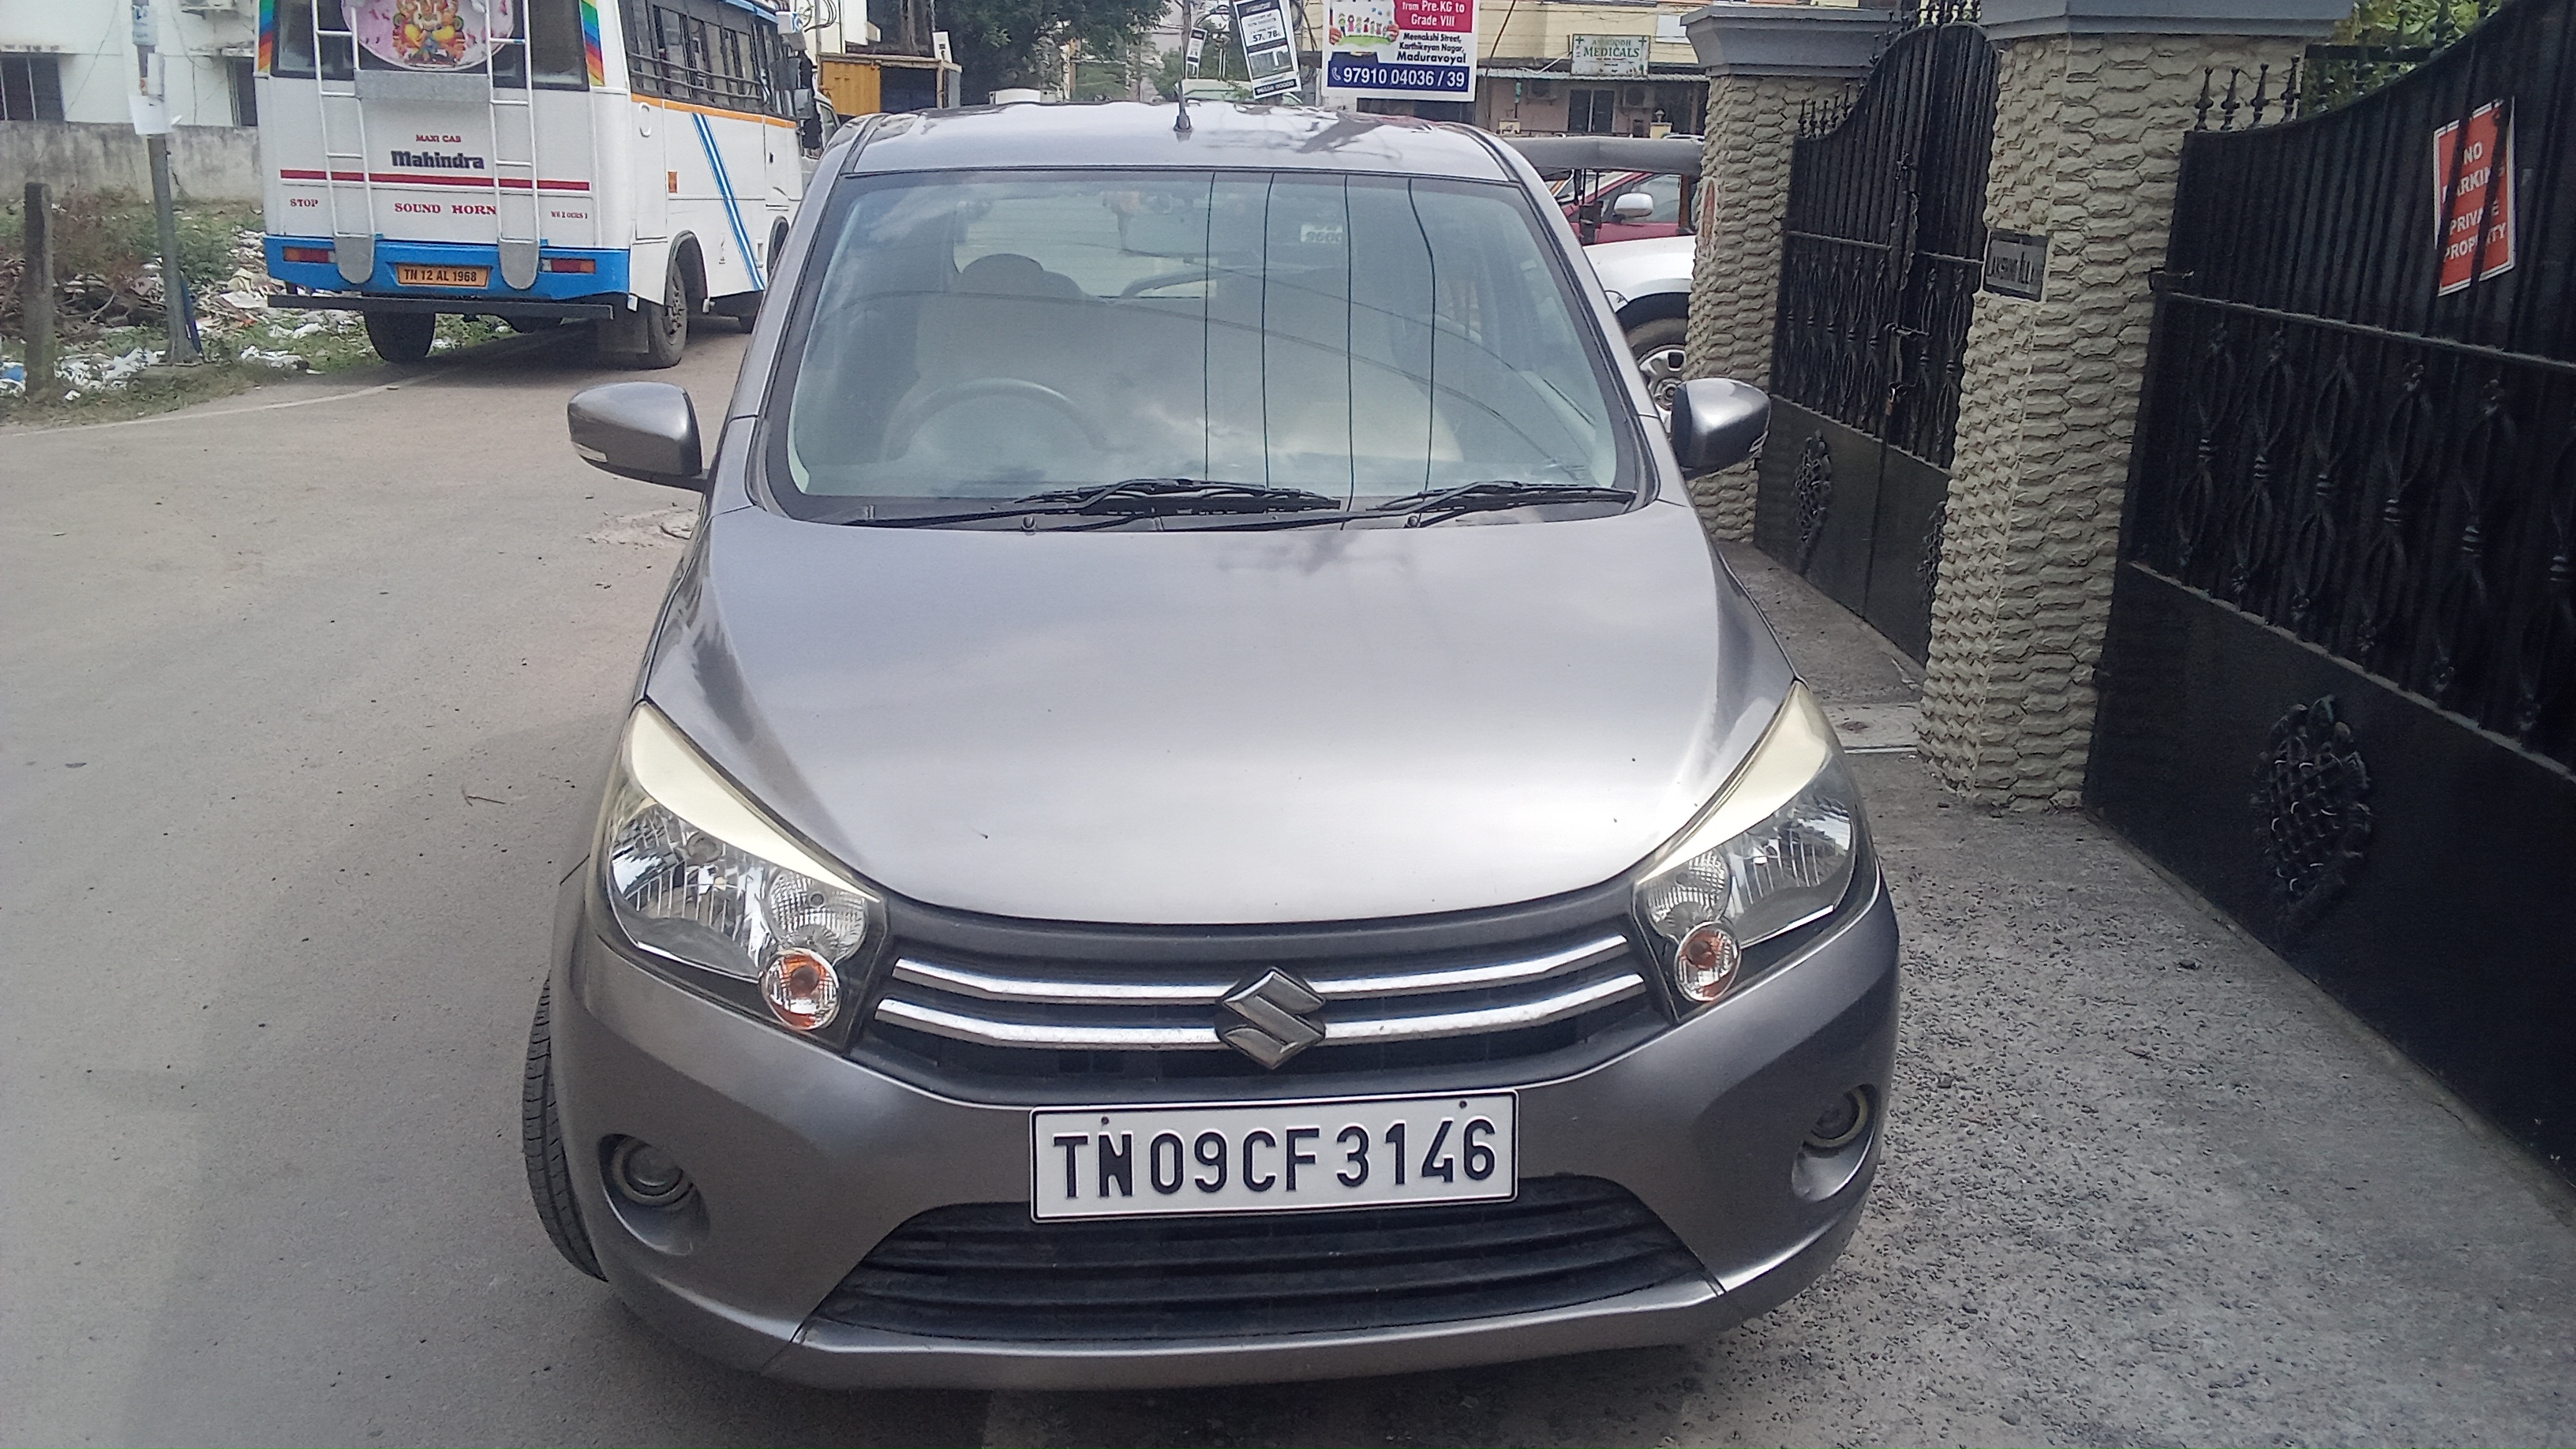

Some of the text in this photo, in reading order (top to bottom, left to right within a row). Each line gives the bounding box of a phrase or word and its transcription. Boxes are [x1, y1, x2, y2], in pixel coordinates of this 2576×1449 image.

[1455, 3, 1465, 13] to
[1411, 13, 1455, 27] Grade VIII
[1403, 32, 1462, 43] Meenakshi Street,
[1398, 42, 1464, 54] Karthikeyan Nagar,
[1583, 47, 1640, 58] MEDICALS
[1396, 51, 1466, 65] Maduravoyal
[1343, 67, 1387, 84] 97910
[1391, 69, 1435, 86] 04036
[1447, 72, 1465, 87] 39
[391, 150, 485, 169] Mahindra
[2463, 141, 2483, 165] NO
[2442, 163, 2505, 204] ARKI
[290, 198, 318, 207] STOP
[395, 203, 496, 215] SOUND HORN
[2449, 198, 2499, 236] PRIVE
[2443, 222, 2507, 263] PROPTY
[404, 269, 477, 282] TN 12 AL 1968
[1053, 1116, 1496, 1198] TN09CF3146
